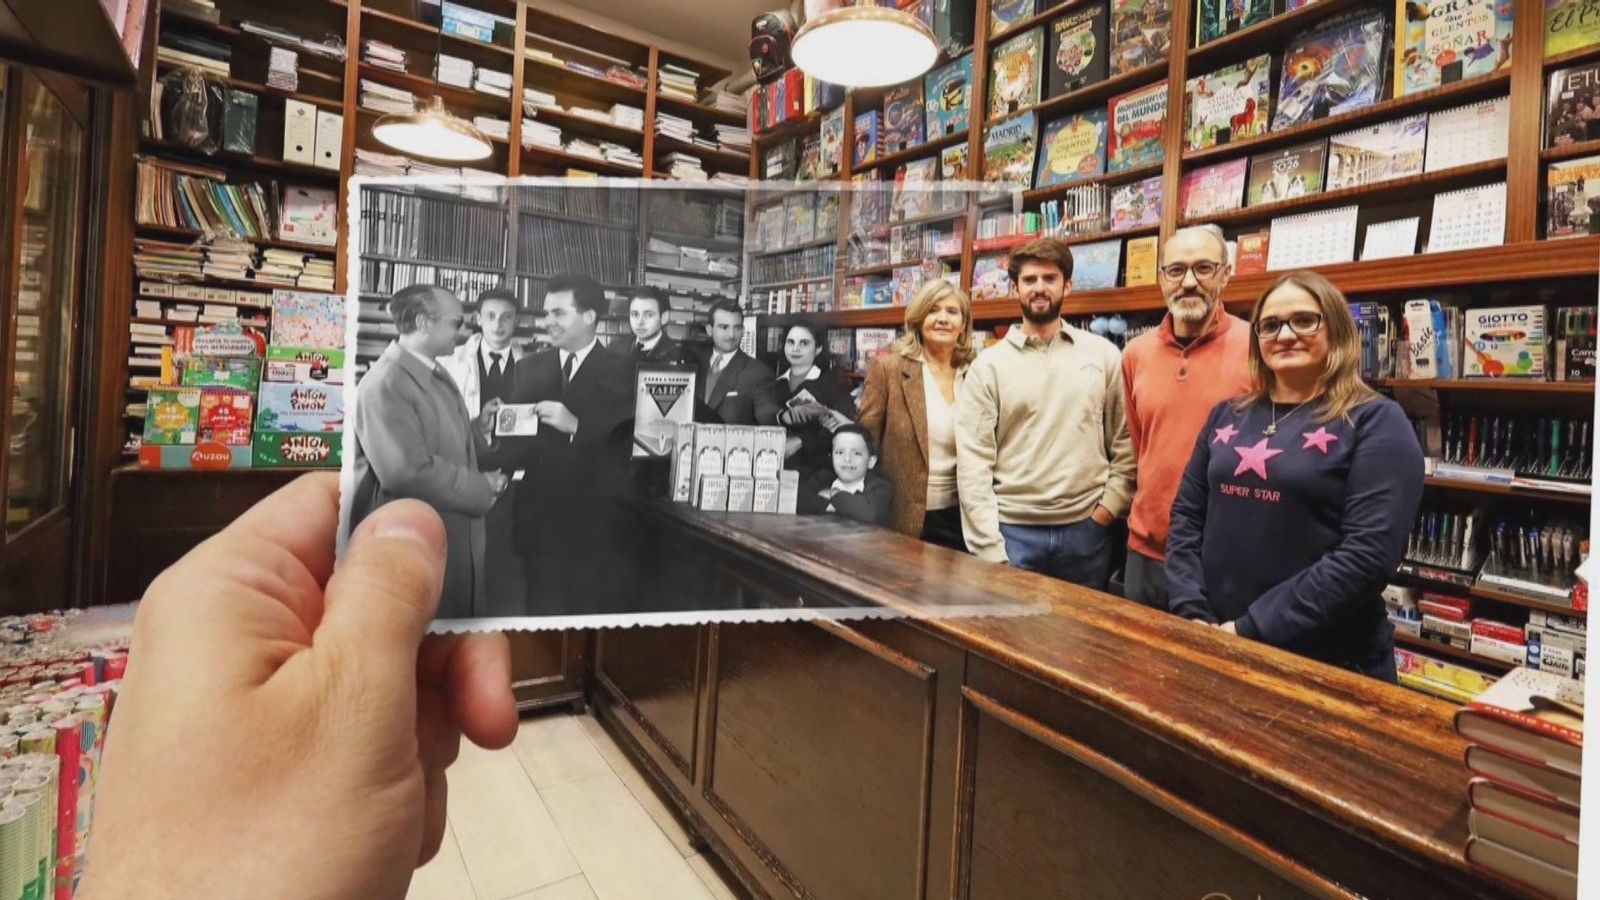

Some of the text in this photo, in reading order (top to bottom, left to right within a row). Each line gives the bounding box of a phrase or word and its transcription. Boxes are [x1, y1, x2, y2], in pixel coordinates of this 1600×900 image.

[990, 124, 1022, 141] MADRID
[1478, 313, 1529, 324] GIOTTO
[1220, 483, 1282, 502] SUPER STAR
